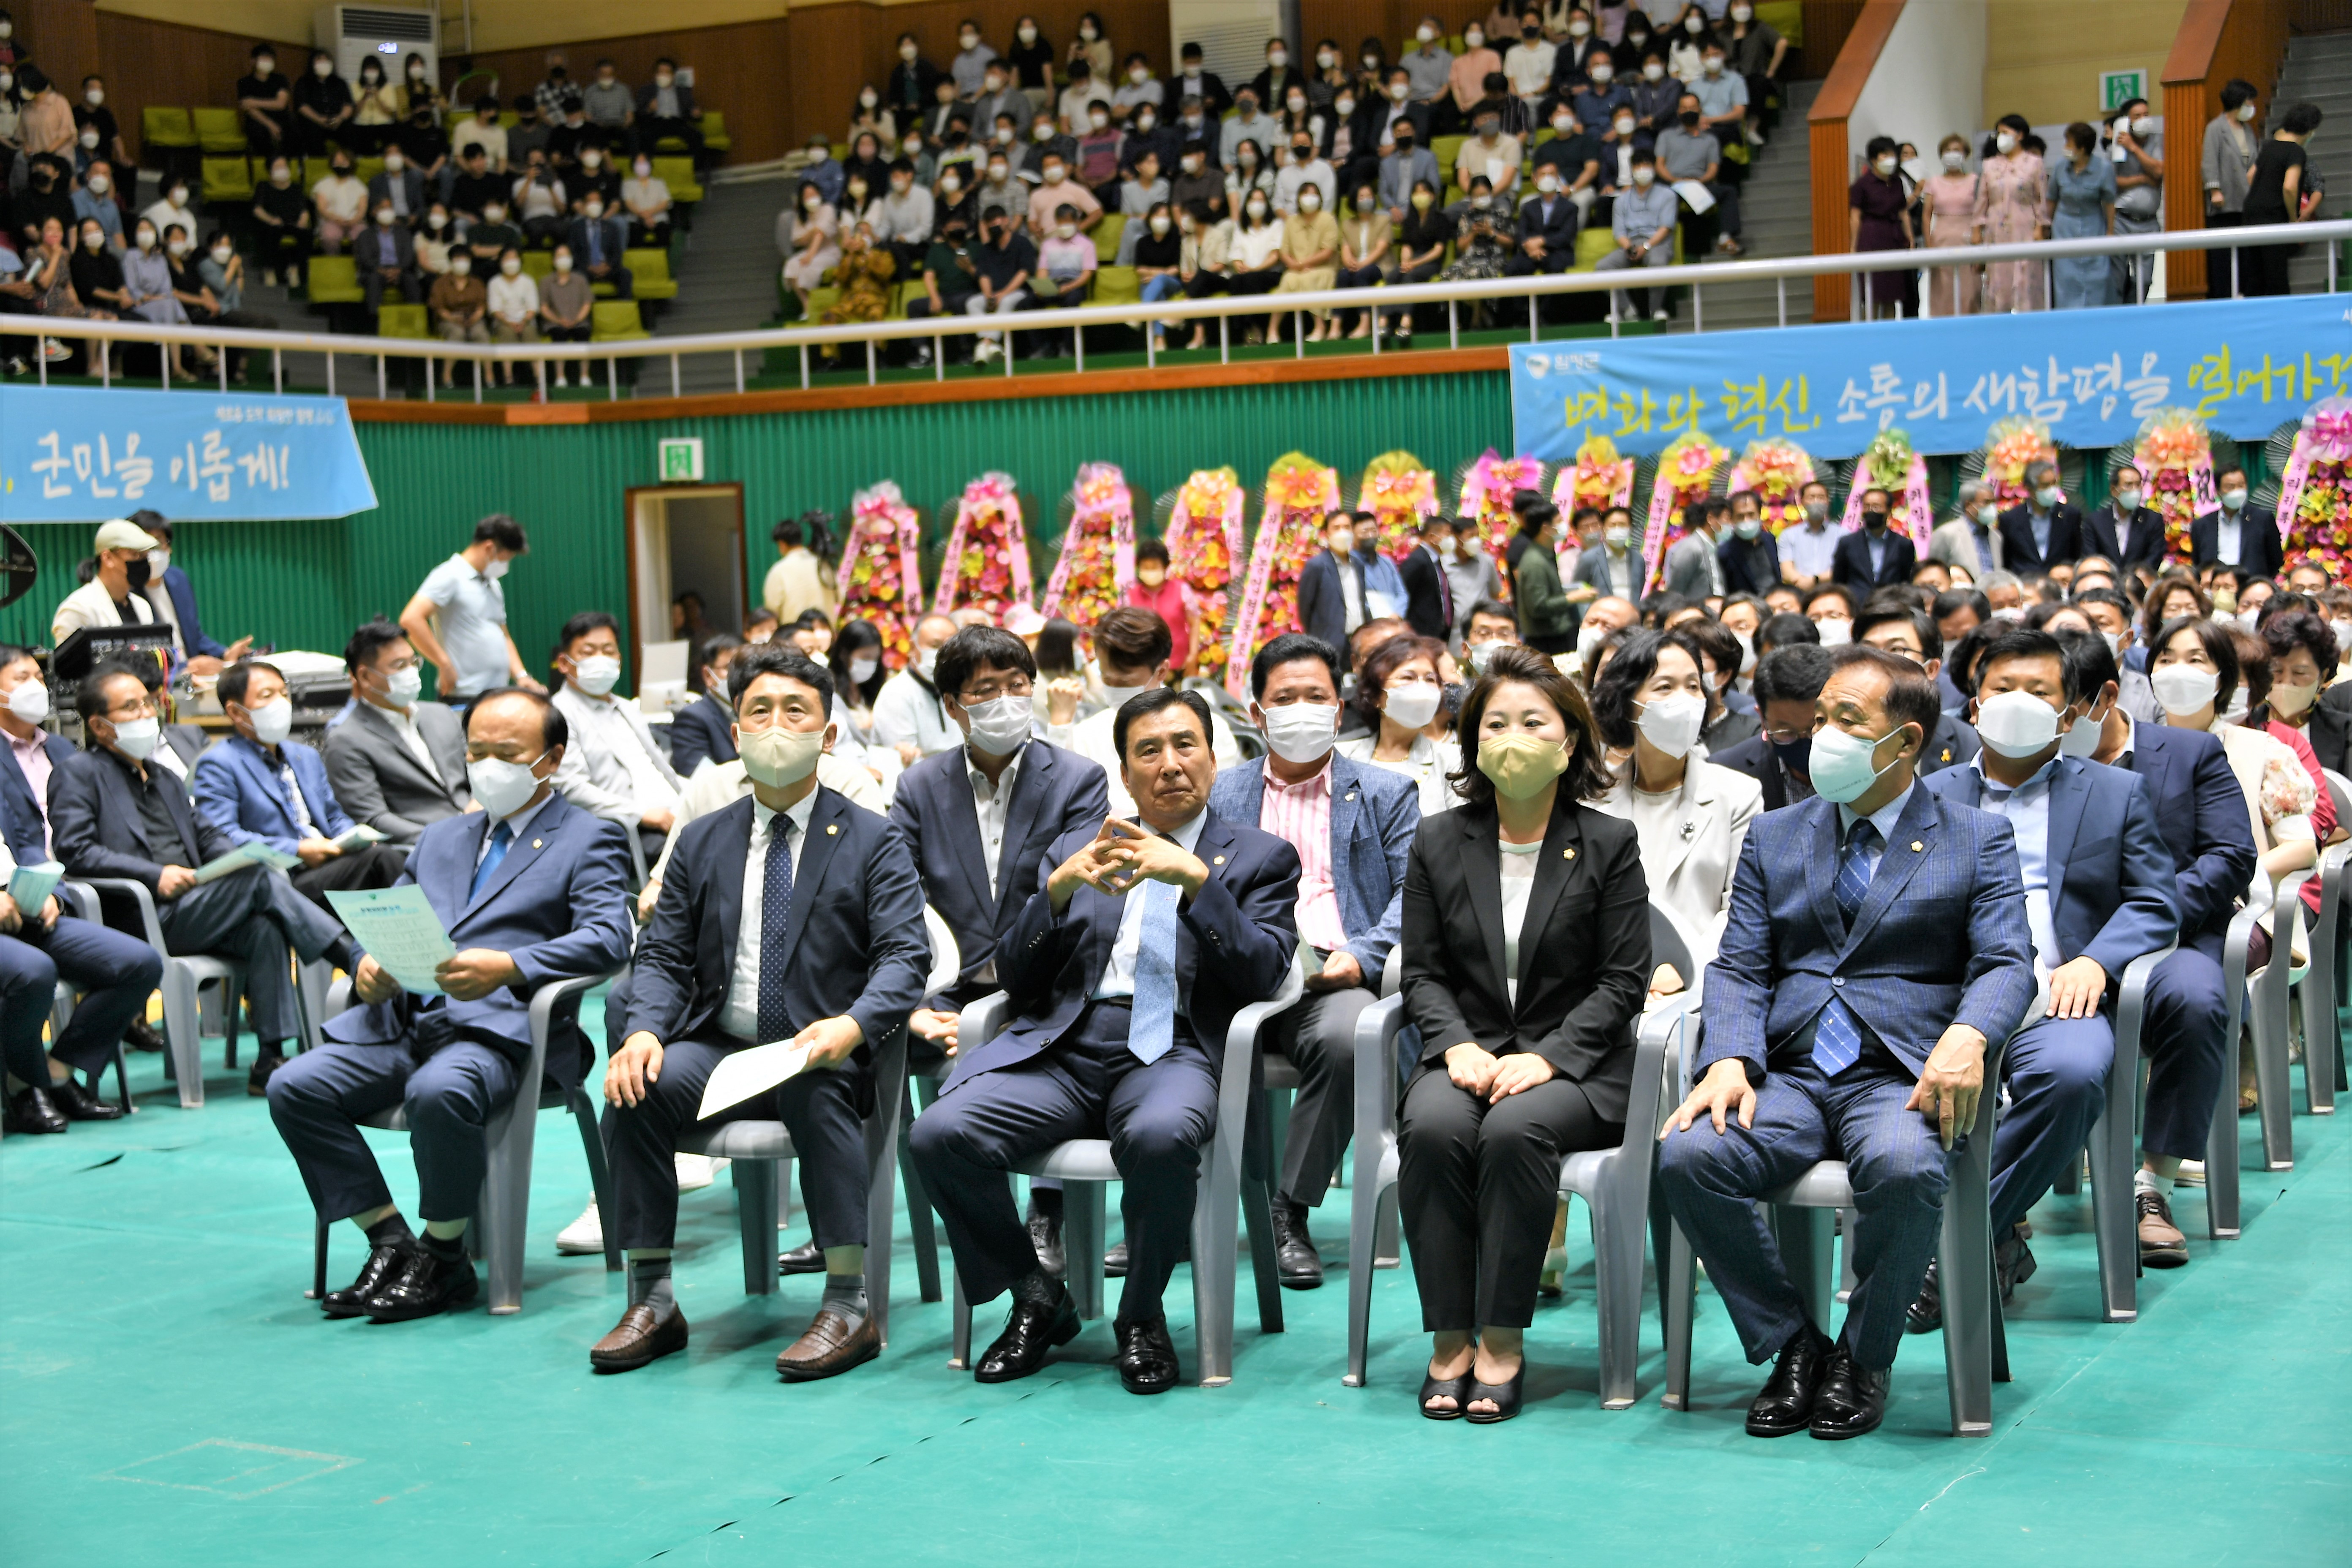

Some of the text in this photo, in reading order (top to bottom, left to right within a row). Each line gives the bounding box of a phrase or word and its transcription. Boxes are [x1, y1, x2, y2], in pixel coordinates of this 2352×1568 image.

[1565, 385, 1706, 441] 변화와
[1720, 374, 1821, 436] 혁신,
[1837, 362, 1948, 432] 소통의
[31, 430, 154, 500] 군민을
[170, 429, 290, 502] 이롭게!
